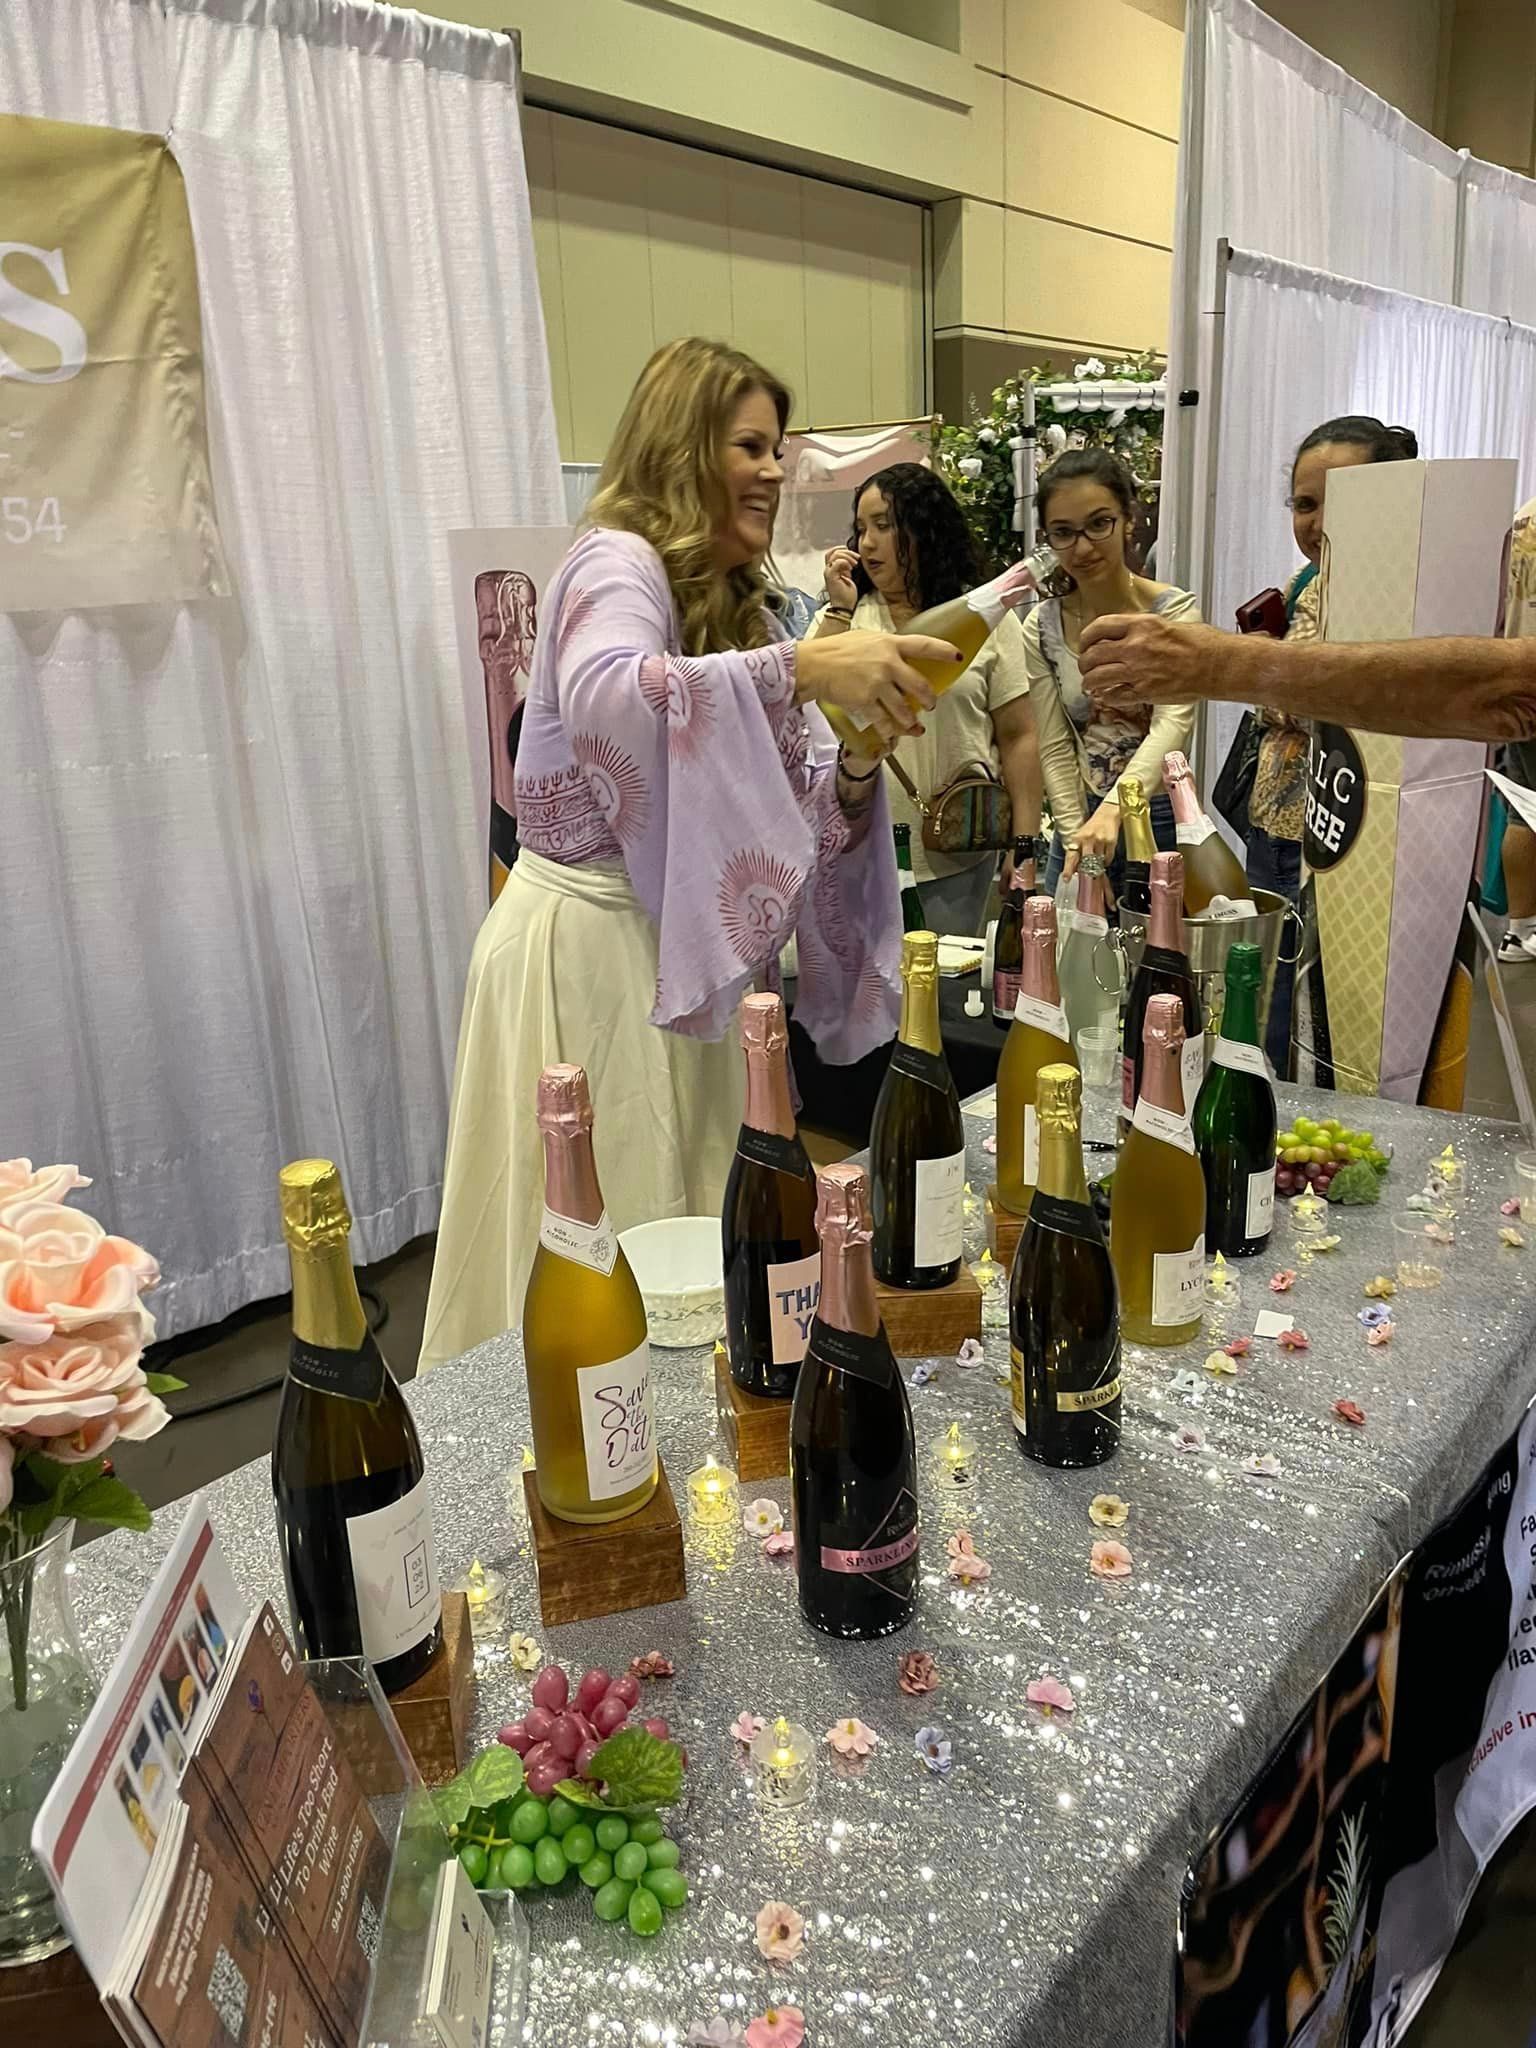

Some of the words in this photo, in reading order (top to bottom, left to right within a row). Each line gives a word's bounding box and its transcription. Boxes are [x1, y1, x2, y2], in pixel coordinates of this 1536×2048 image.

[279, 1825, 305, 1887] Life's
[297, 1790, 316, 1829] Too
[308, 1735, 333, 1790] Short
[294, 1867, 312, 1896] To
[303, 1806, 329, 1863] Drink
[320, 1765, 339, 1809] Bad
[318, 1824, 339, 1878] Wine
[330, 1824, 364, 1934] 941-900-1285
